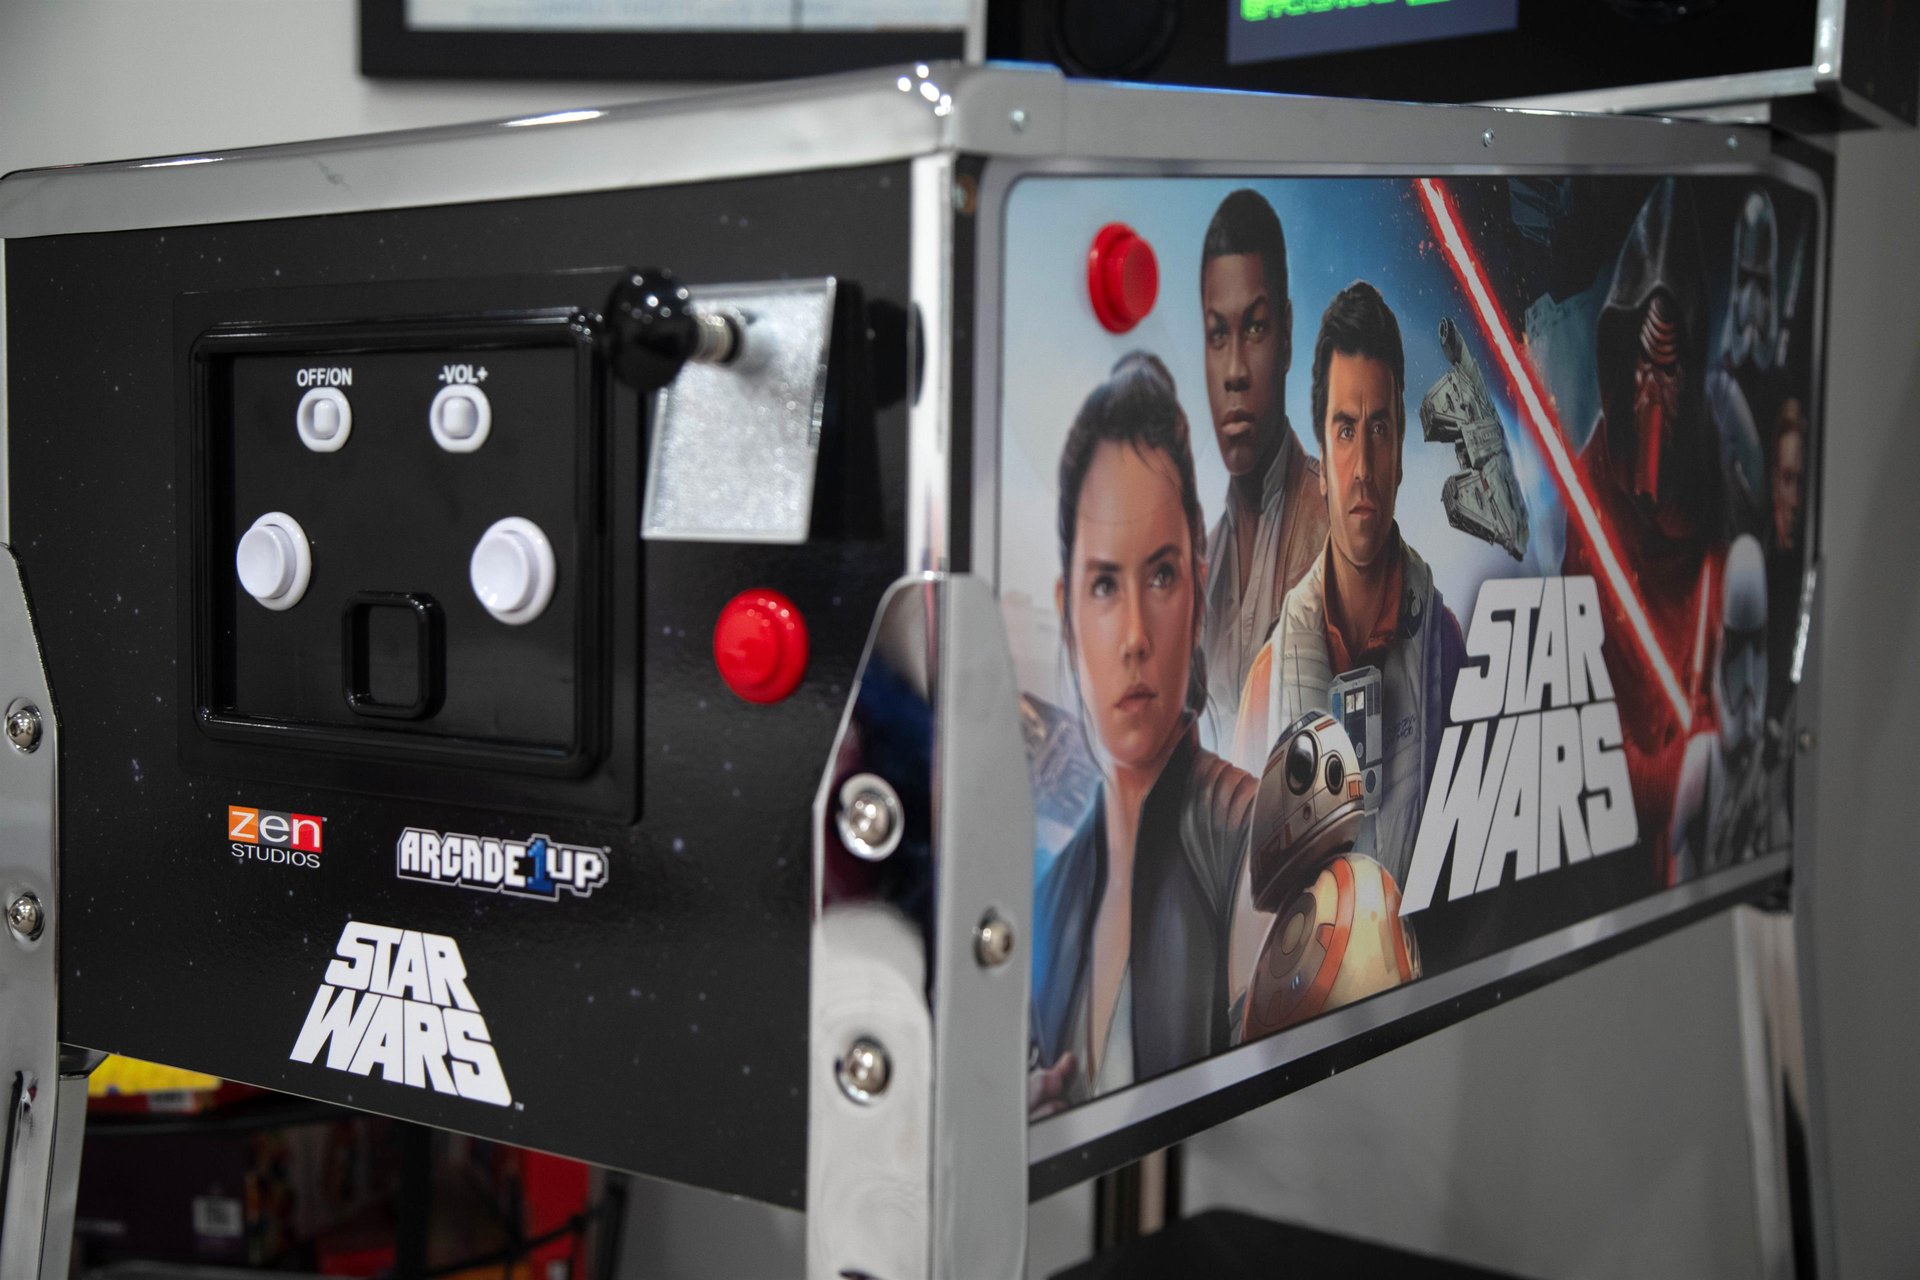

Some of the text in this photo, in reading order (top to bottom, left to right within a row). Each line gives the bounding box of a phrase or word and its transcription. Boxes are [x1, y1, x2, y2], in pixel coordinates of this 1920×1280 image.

[297, 367, 352, 387] OFF/ON
[1450, 575, 1616, 724] STAR
[231, 811, 320, 848] zen
[1398, 701, 1638, 917] WARS
[231, 843, 321, 869] STUDIOS
[400, 831, 603, 892] ARCADE1UP
[324, 921, 481, 1013] STAR
[289, 984, 512, 1107] WARS
